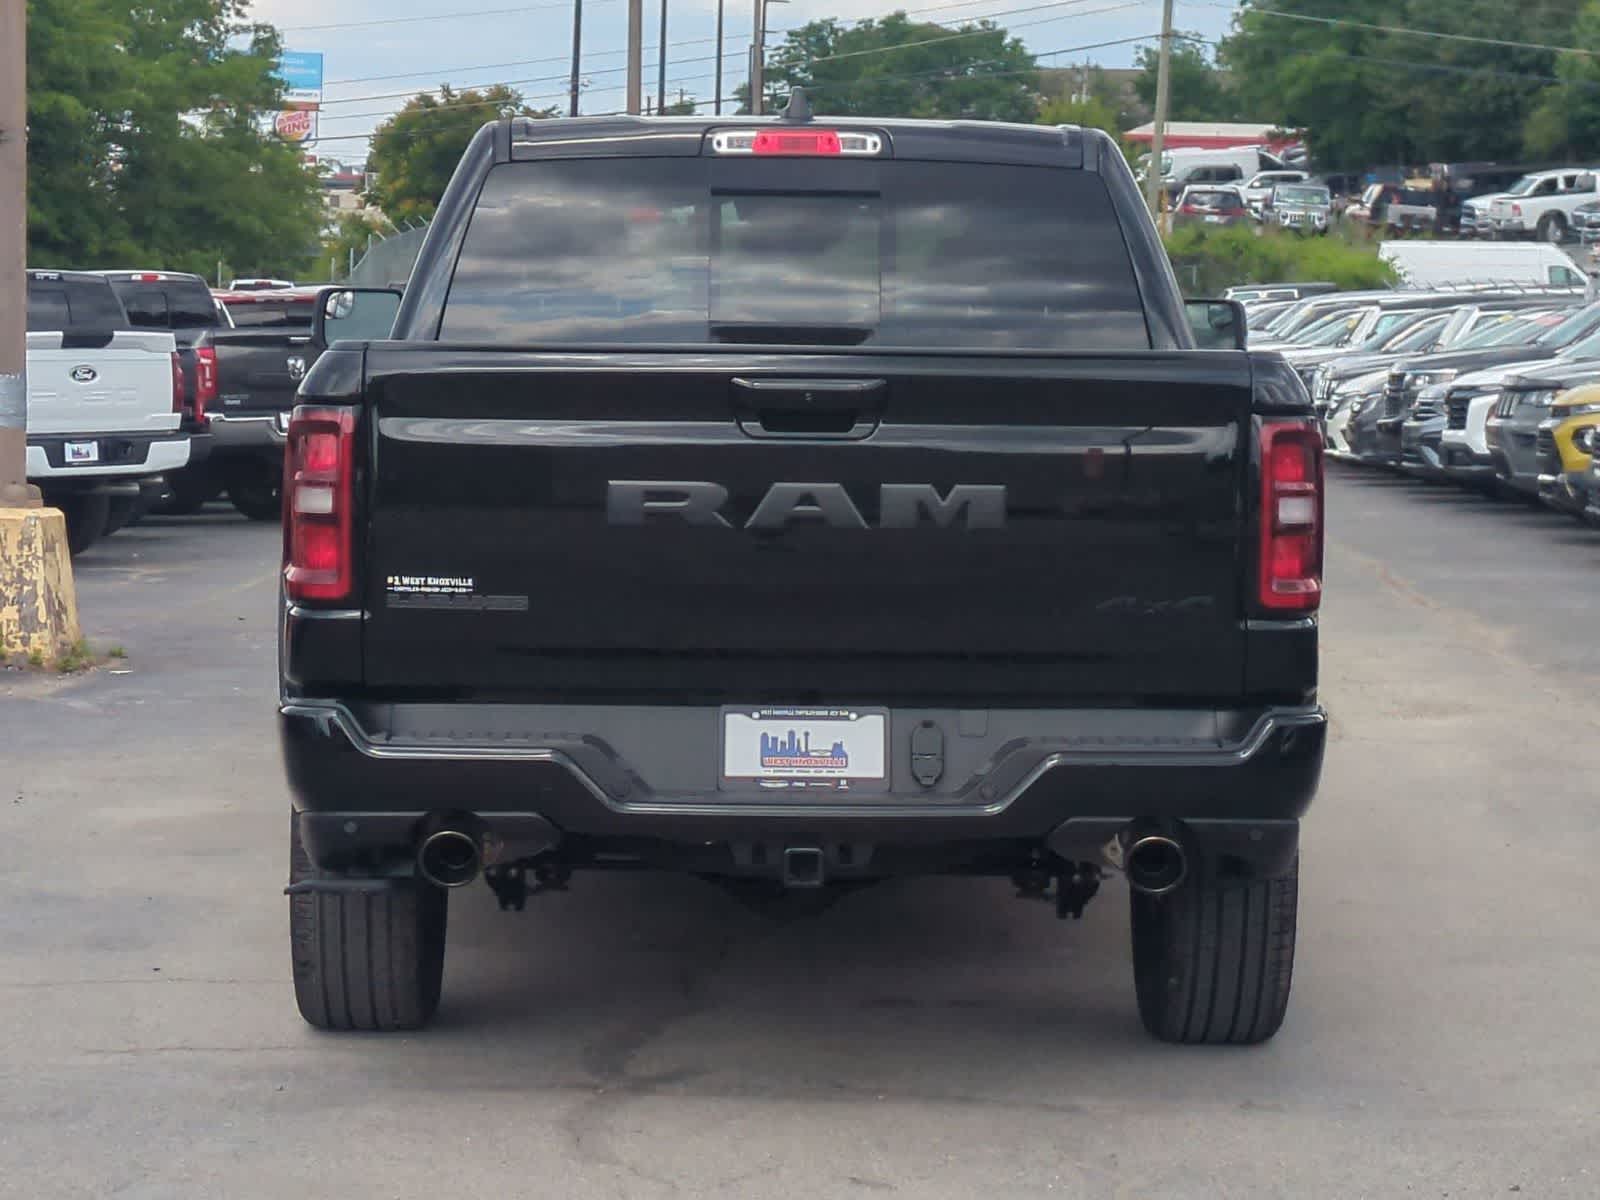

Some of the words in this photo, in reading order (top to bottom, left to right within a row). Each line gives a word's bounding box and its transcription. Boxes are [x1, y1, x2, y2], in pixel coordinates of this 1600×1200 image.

[280, 120, 310, 134] KING
[607, 479, 1007, 530] RAM
[402, 576, 426, 586] WEST
[427, 577, 473, 587] KNOXVILLE
